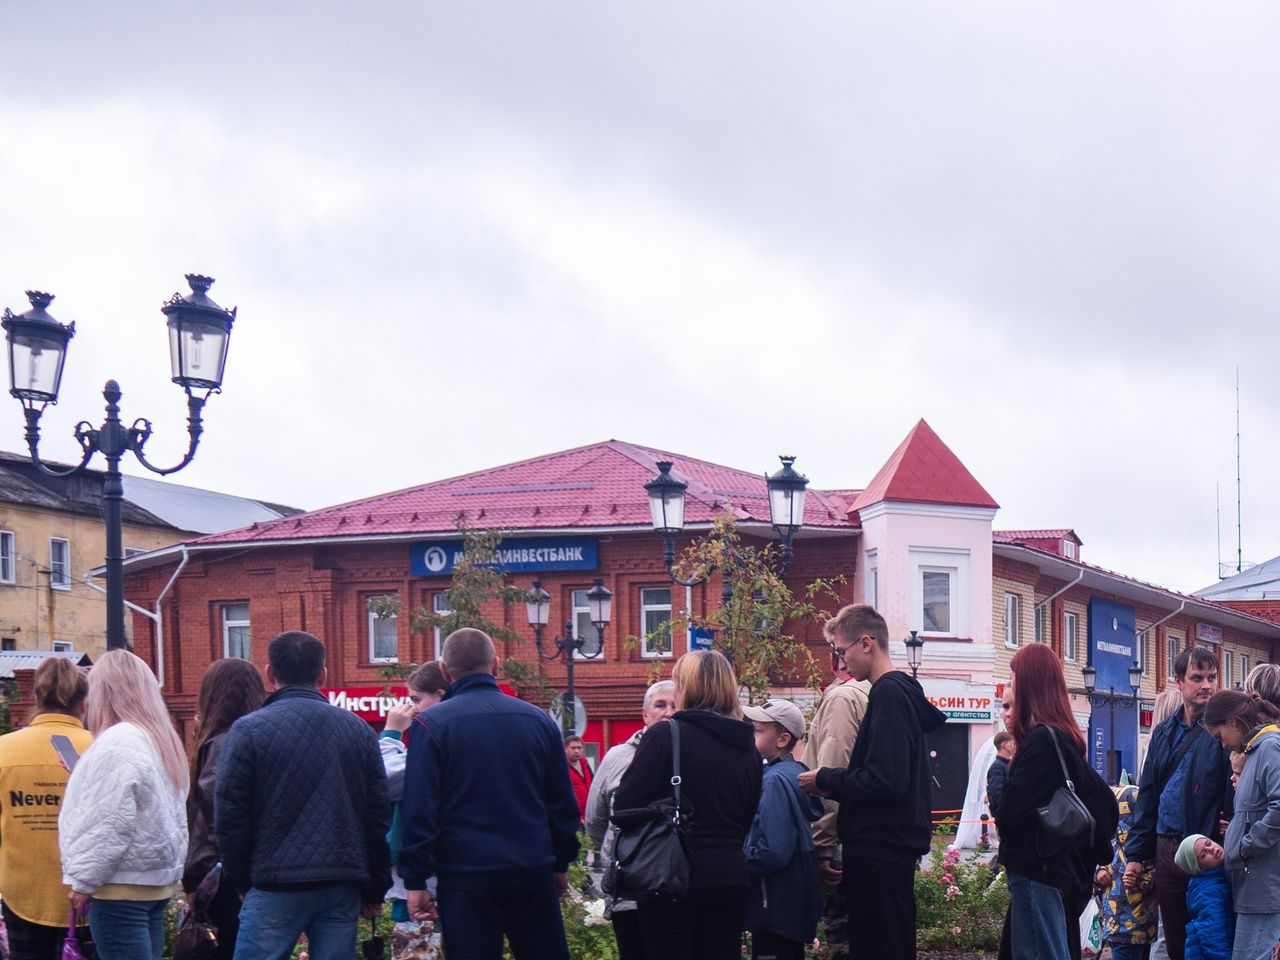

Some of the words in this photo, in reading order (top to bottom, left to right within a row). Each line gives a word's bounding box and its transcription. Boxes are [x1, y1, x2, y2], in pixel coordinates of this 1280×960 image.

[925, 696, 965, 708] ЬСИН
[968, 697, 991, 708] ТУР
[10, 791, 60, 807] Never
